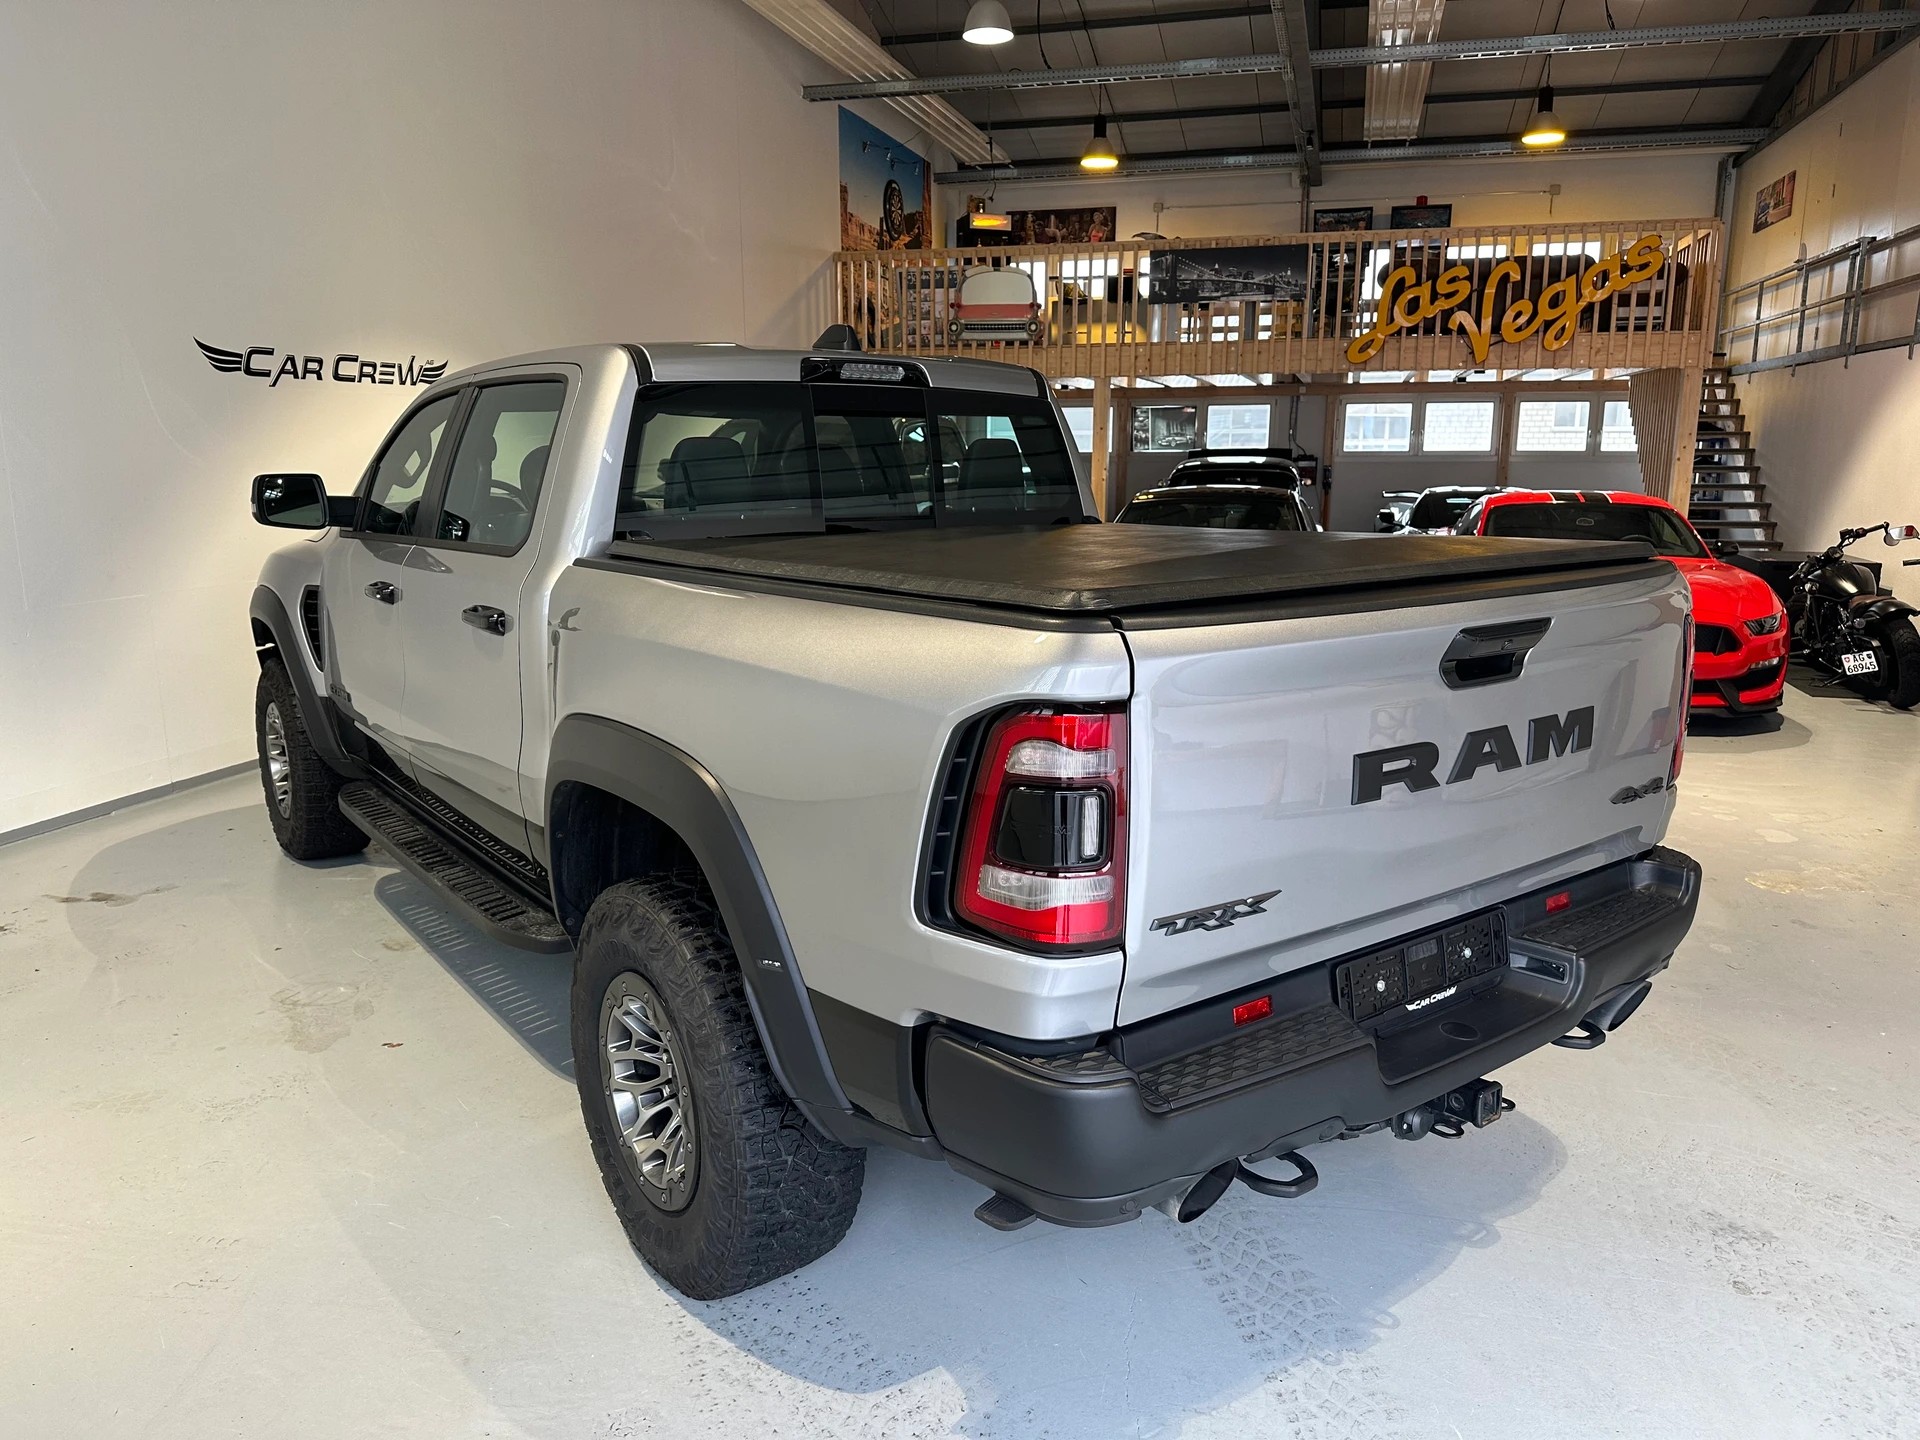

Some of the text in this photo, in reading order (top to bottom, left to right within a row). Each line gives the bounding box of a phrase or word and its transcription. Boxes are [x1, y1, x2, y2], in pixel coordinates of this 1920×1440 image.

[1346, 234, 1665, 364] Las Vegas
[243, 346, 323, 387] CAR
[332, 354, 424, 386] CREW
[1847, 661, 1877, 674] 68945
[1852, 653, 1866, 663] AG
[1351, 705, 1595, 805] RAM
[1149, 889, 1283, 936] TRX
